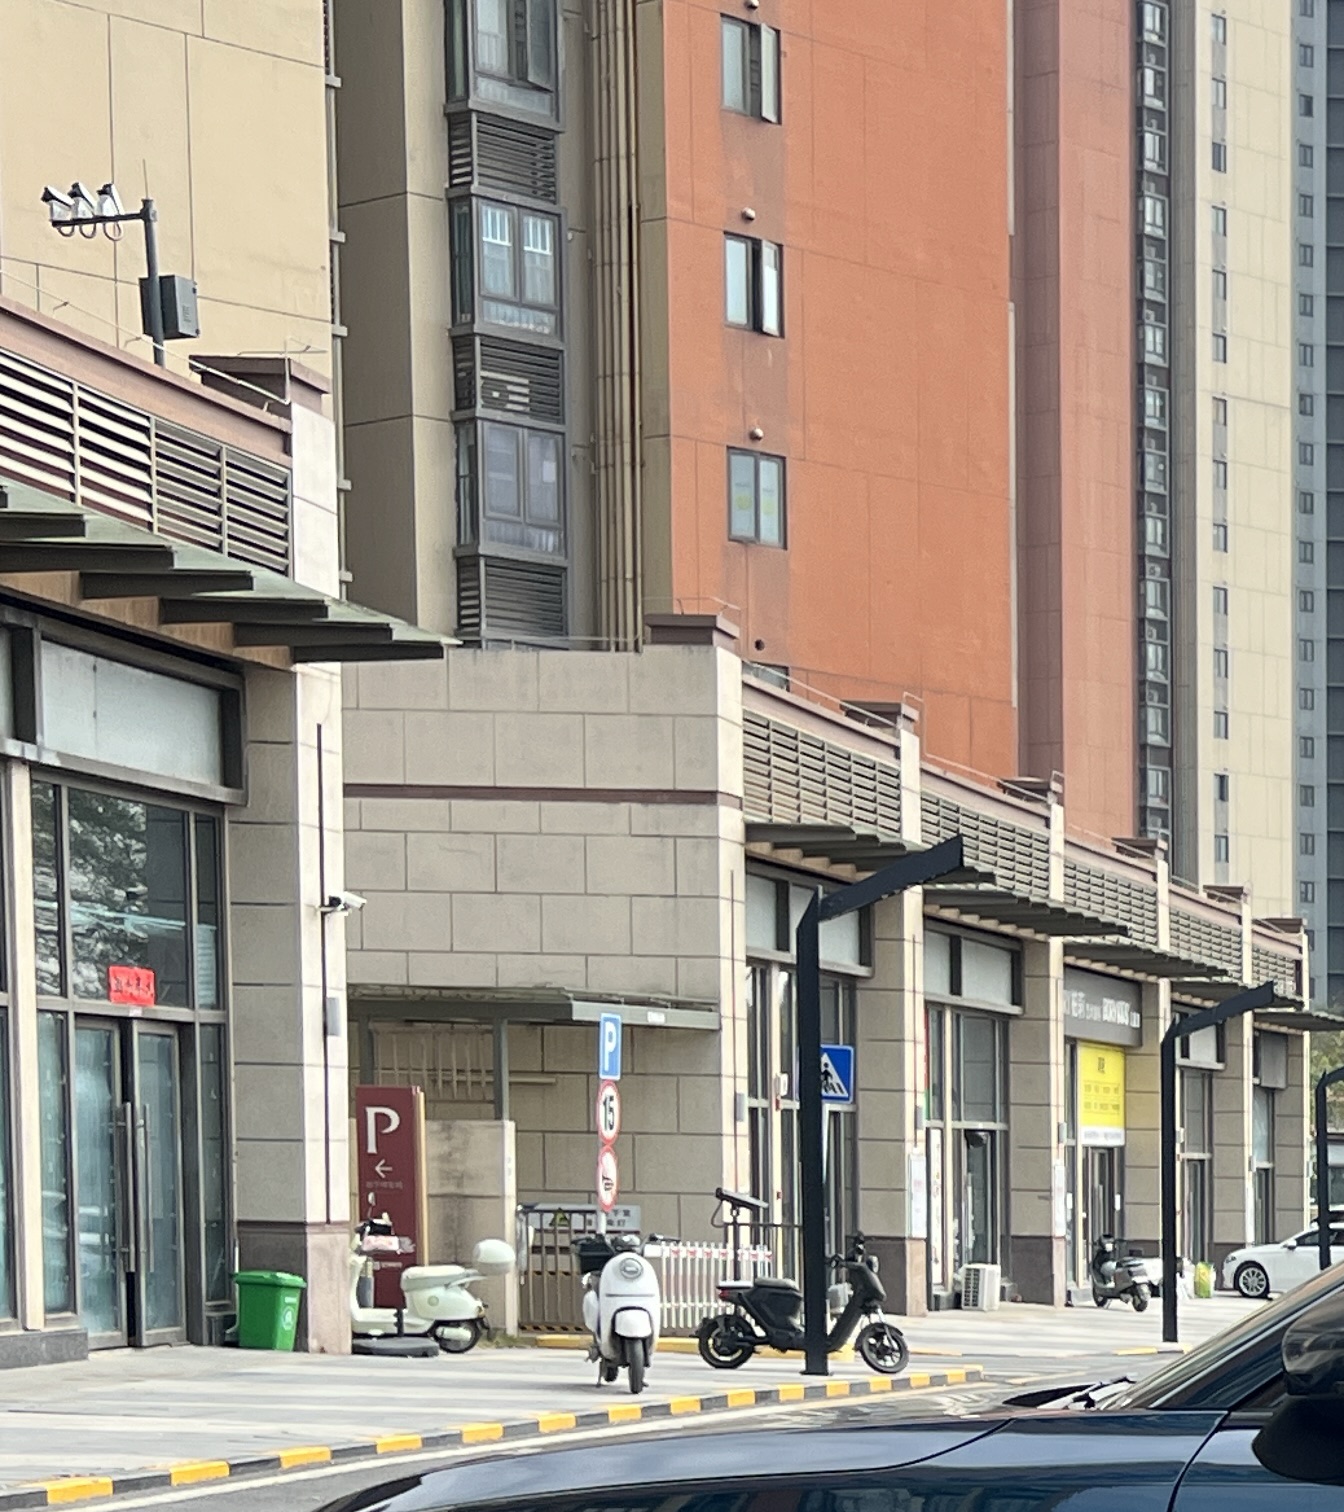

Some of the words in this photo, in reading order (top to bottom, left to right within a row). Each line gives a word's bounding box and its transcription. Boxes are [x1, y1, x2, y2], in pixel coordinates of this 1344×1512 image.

[604, 1021, 617, 1072] P
[365, 1106, 401, 1154] P
[603, 1095, 615, 1131] 15
